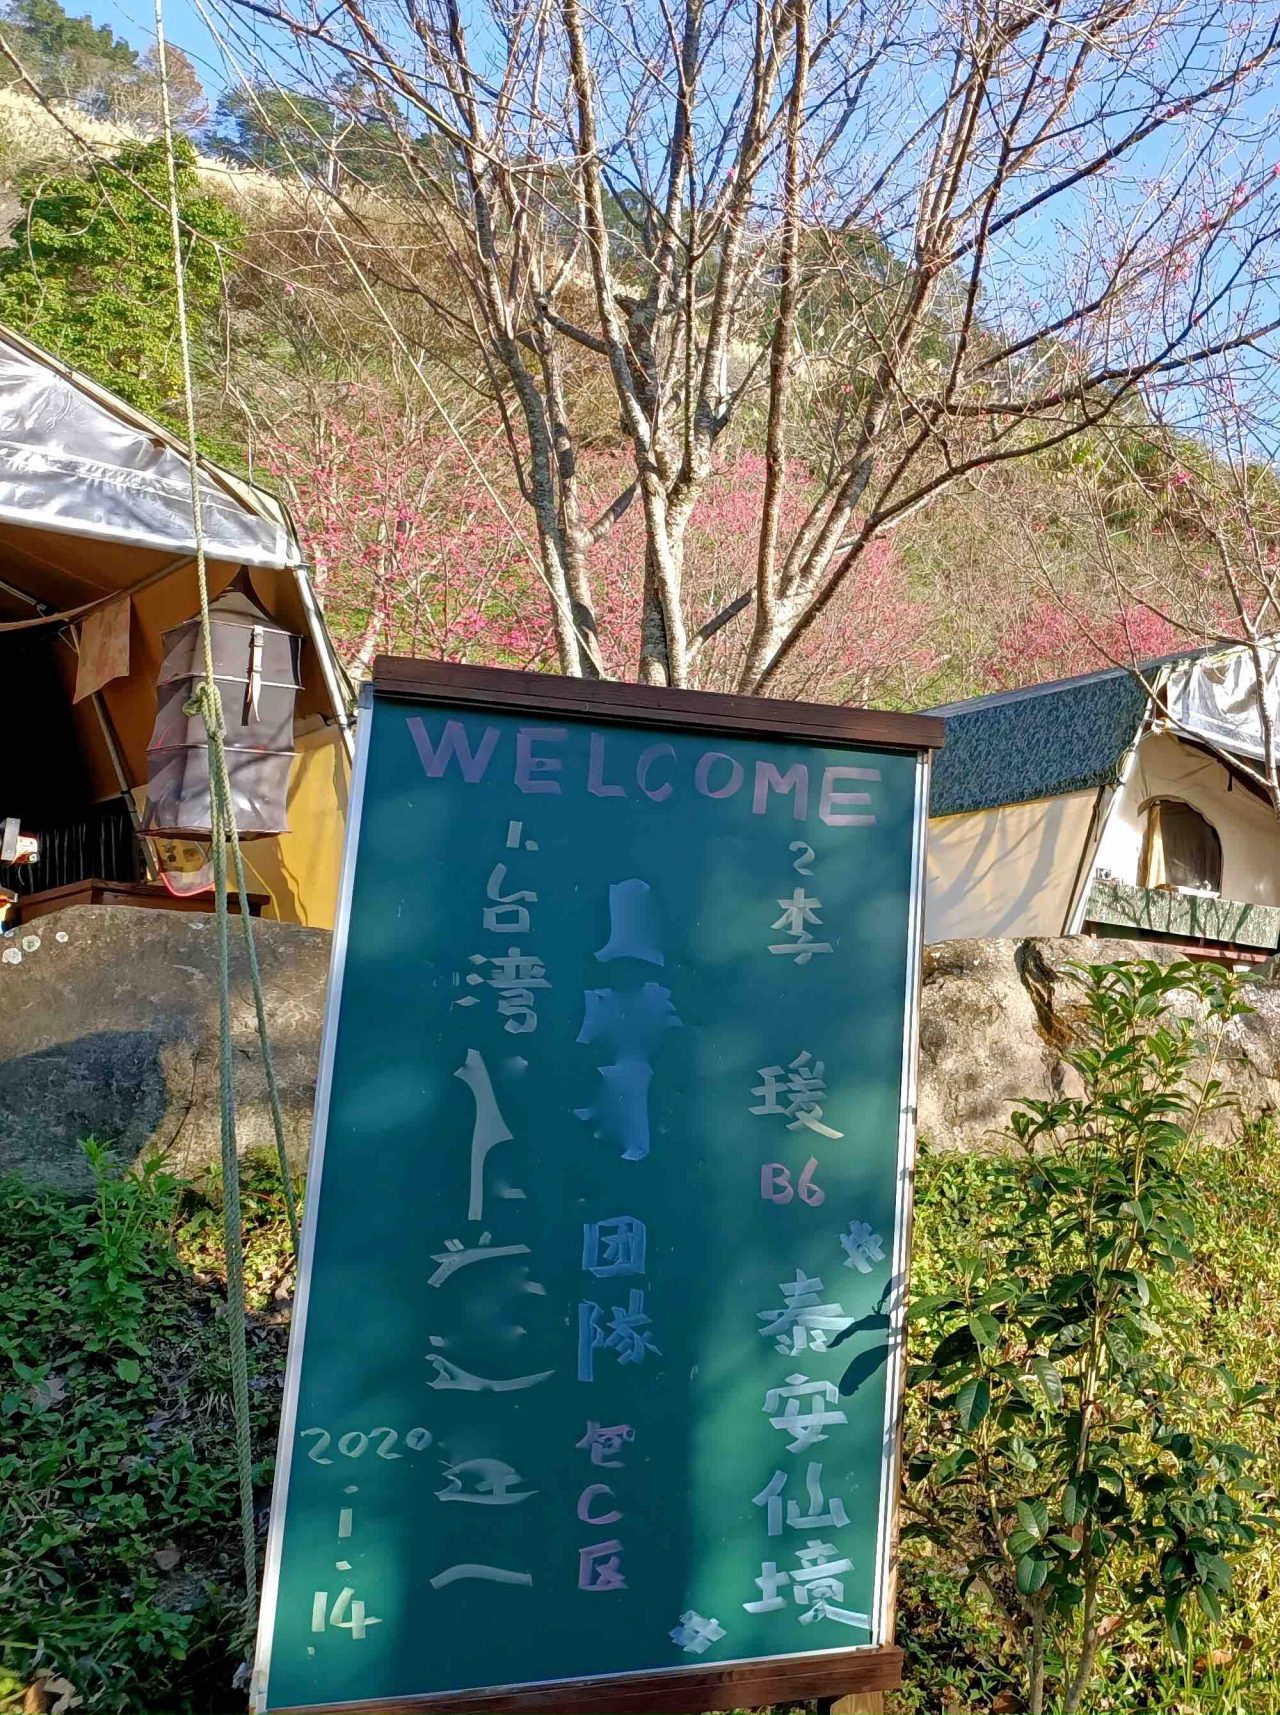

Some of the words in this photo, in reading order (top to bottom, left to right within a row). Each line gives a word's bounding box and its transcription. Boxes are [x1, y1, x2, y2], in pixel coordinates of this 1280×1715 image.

[405, 716, 883, 827] WELCOME
[760, 1155, 825, 1207] B6
[742, 1268, 871, 1630] 泰安仙境
